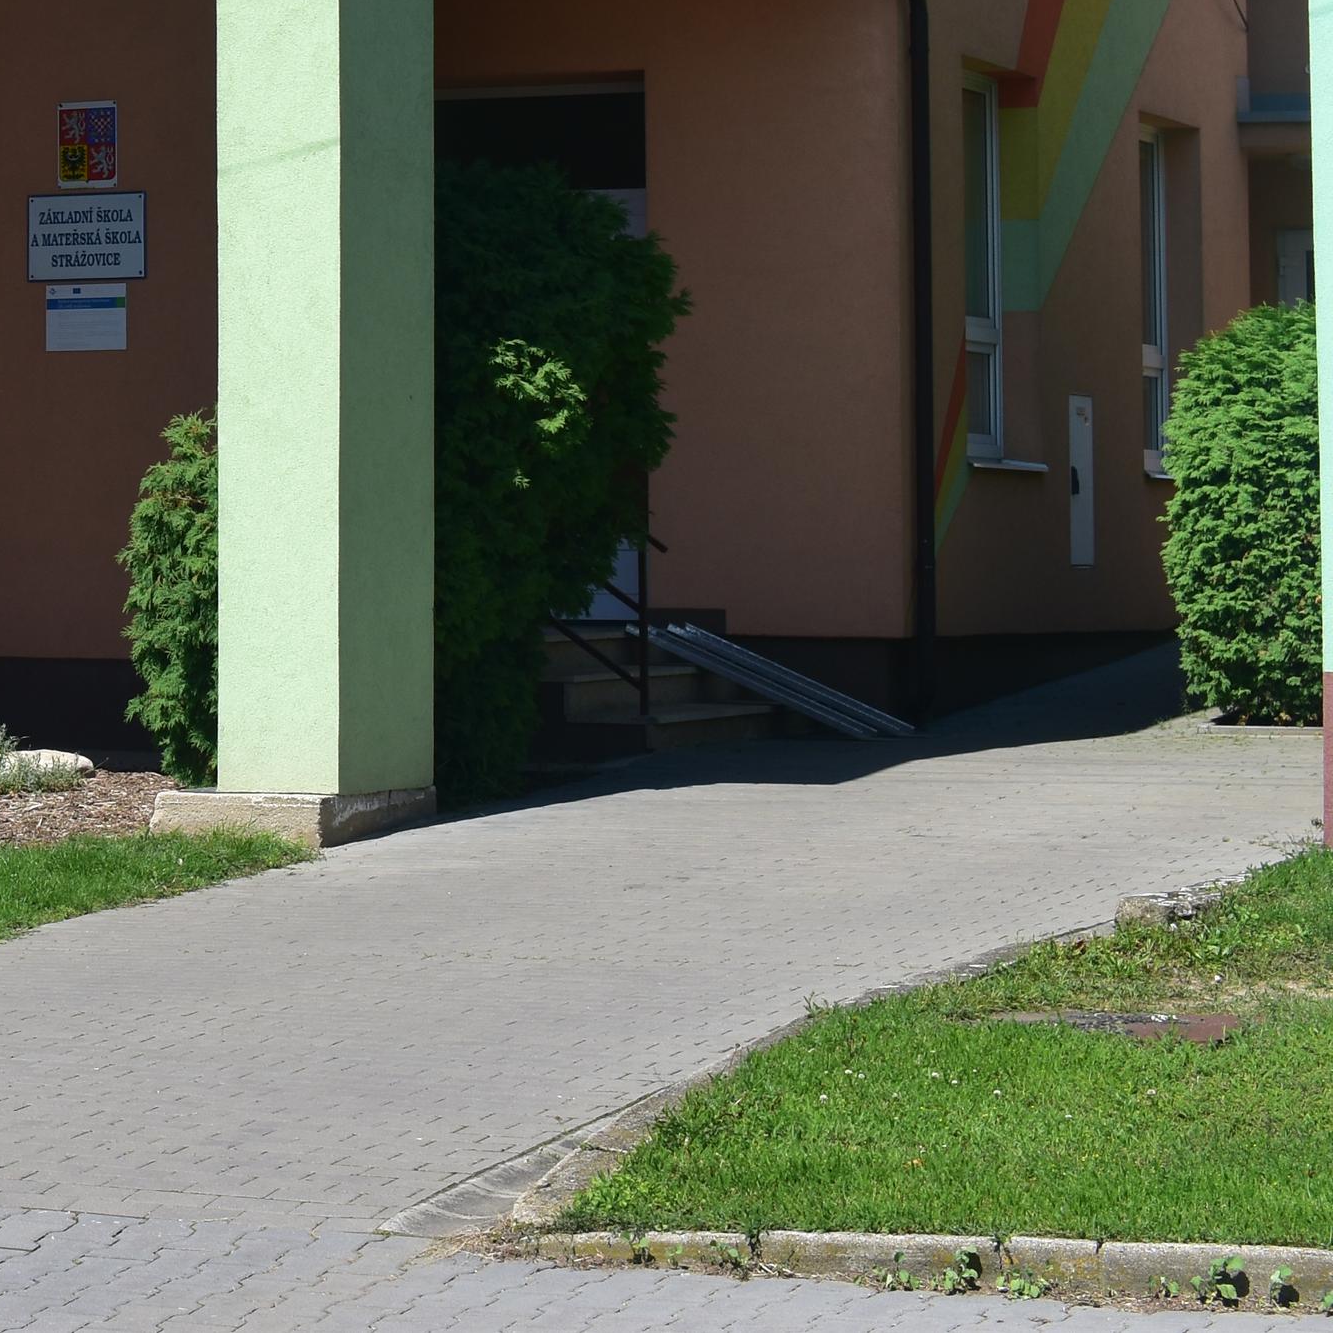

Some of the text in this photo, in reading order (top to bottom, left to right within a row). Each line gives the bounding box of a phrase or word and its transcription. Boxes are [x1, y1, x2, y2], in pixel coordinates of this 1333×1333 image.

[39, 207, 133, 225] ZÁKLADNÍ ŠKOLA
[31, 228, 142, 247] A MATEŘSKÁ ŠKOLA
[51, 251, 121, 268] STRÁŽOVICE
